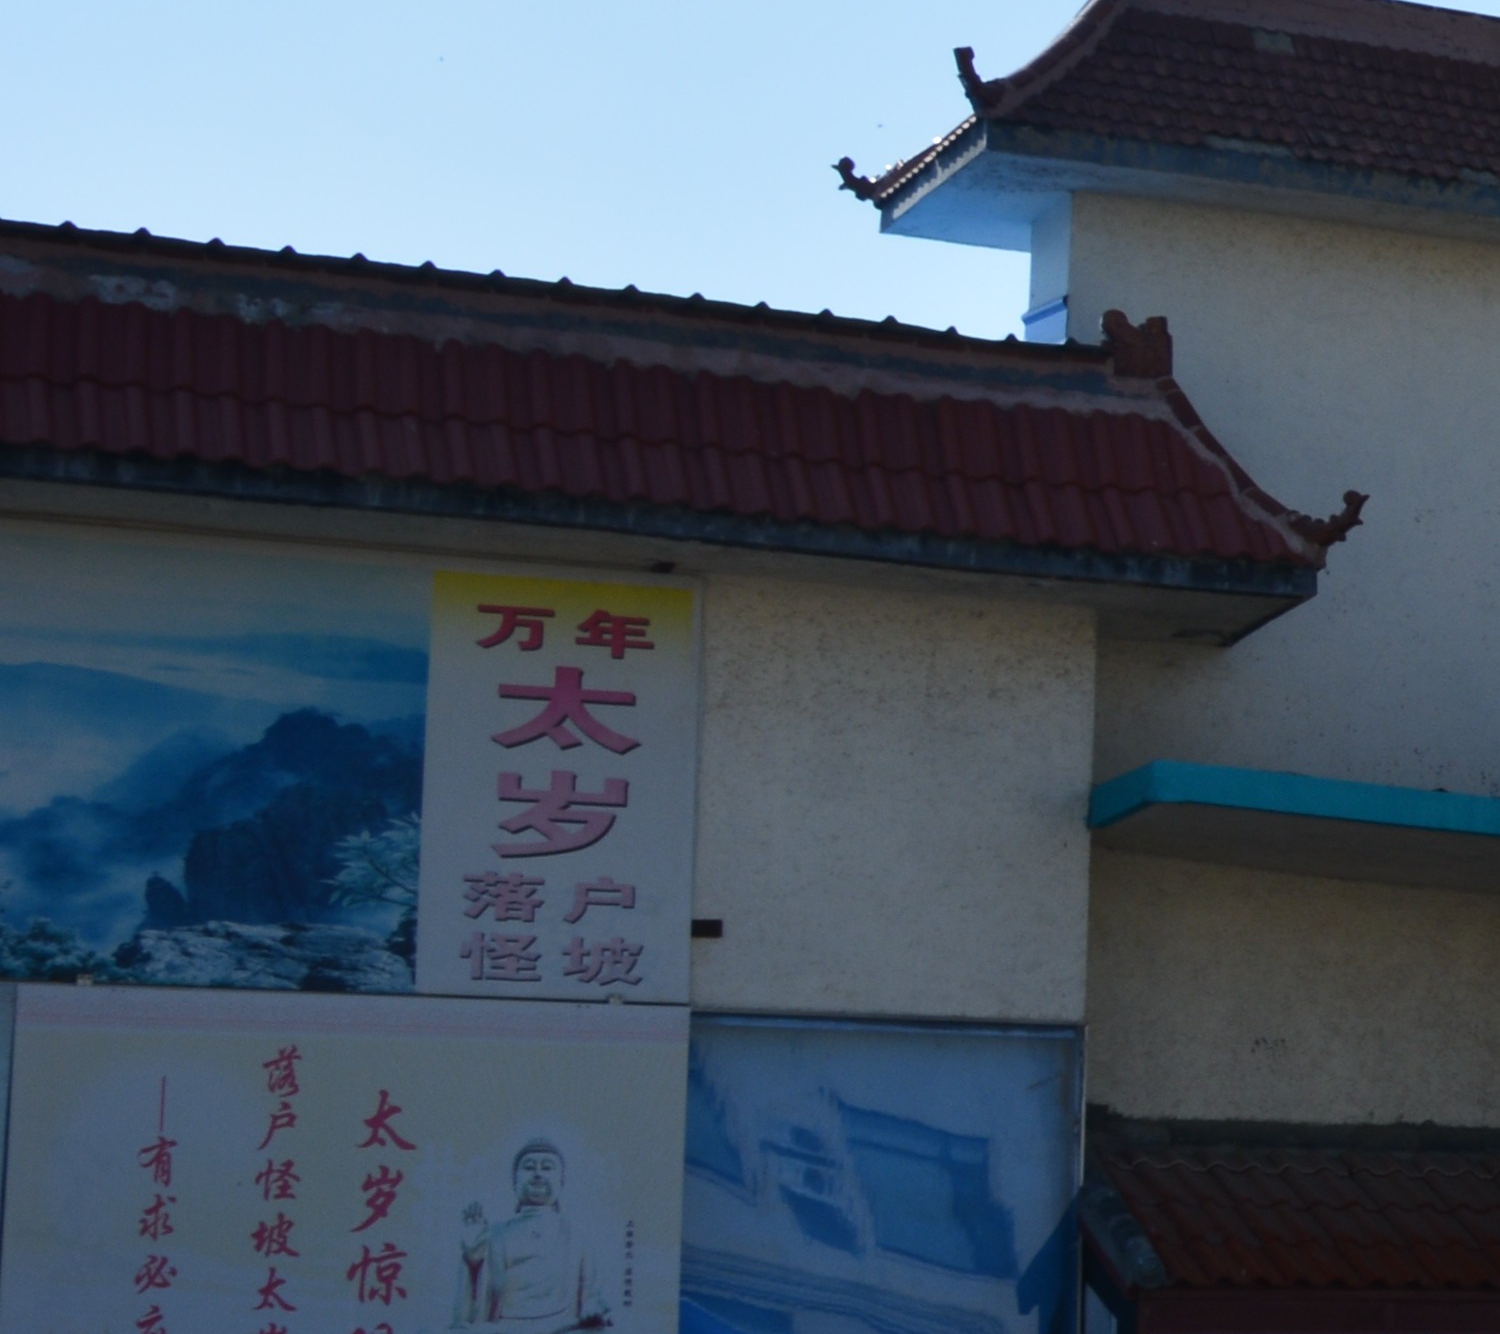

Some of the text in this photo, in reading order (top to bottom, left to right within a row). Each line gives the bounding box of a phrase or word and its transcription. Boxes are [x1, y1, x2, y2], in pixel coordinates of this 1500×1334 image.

[476, 603, 656, 659] 万年
[490, 666, 642, 861] 太岁
[461, 872, 637, 924] 落户
[459, 933, 643, 986] 怪坡
